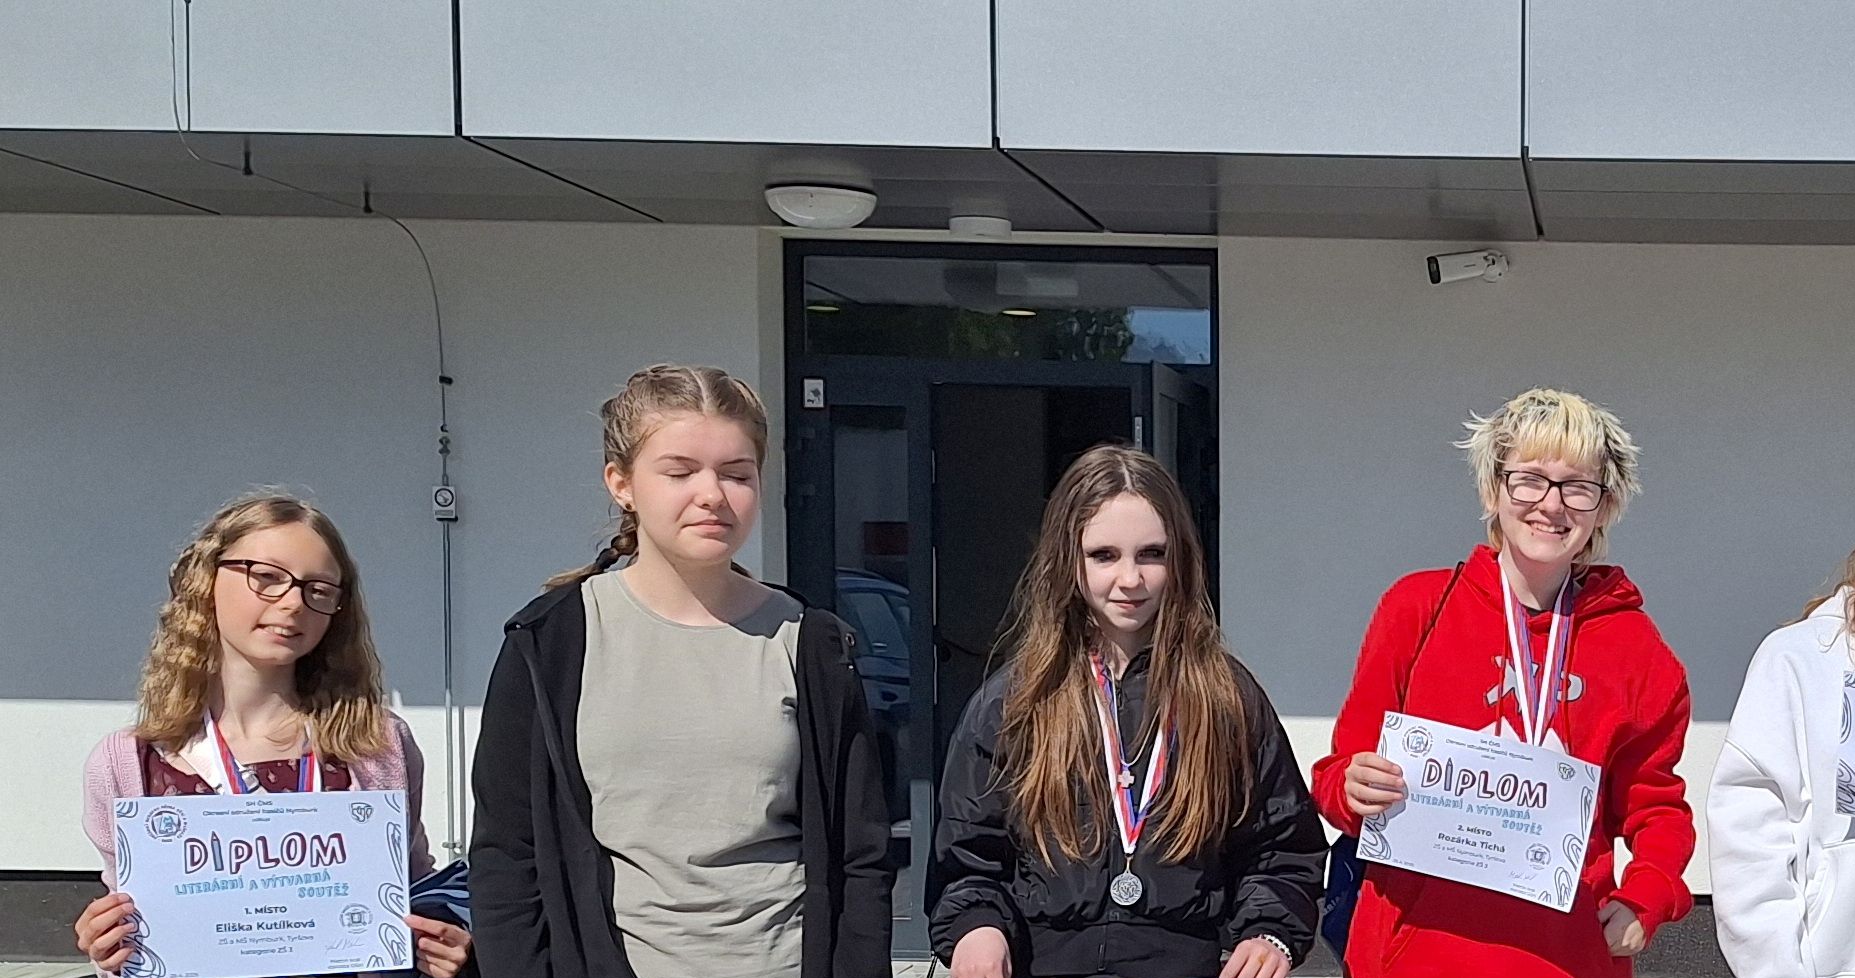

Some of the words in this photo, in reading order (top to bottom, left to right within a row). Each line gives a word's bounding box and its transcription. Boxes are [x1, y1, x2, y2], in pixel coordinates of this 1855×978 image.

[1422, 757, 1547, 808] DIPLOM
[1466, 804, 1473, 813] A
[1466, 826, 1492, 837] MÍSTO
[184, 831, 347, 874] DIPLOM
[175, 877, 243, 895] LITERÁRNÍ
[250, 879, 258, 890] A
[260, 869, 331, 889] VÝTVARNÁ
[298, 883, 349, 898] SOUTĚŽ
[255, 905, 288, 914] MÍSTO
[216, 922, 252, 933] Eliška
[257, 919, 315, 931] Kutílková
